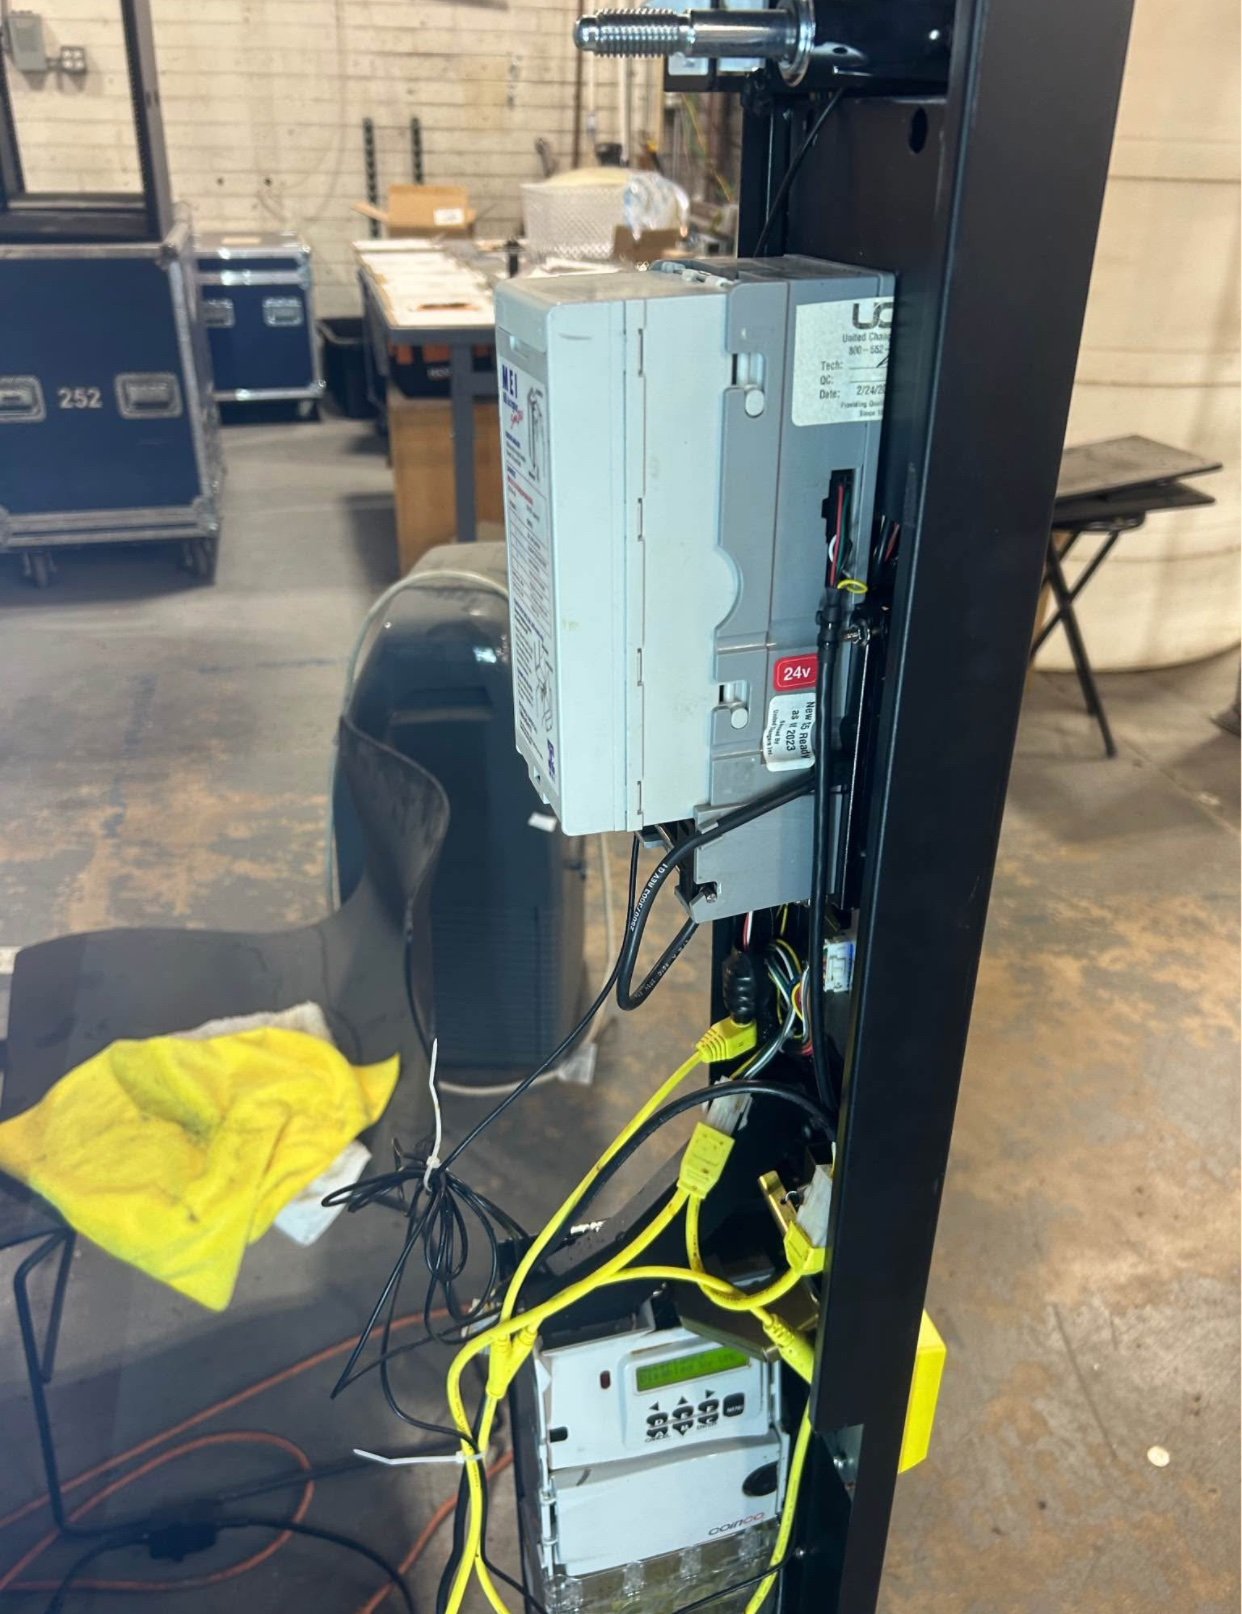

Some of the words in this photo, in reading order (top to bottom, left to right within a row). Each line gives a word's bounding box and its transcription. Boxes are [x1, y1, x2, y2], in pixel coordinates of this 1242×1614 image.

[842, 333, 867, 344] United
[821, 360, 843, 371] Tech:
[502, 364, 518, 399] MEI
[820, 375, 834, 385] QC:
[57, 387, 104, 409] 252
[819, 389, 841, 399] Date:
[783, 666, 811, 681] 24v
[791, 710, 800, 720] as
[805, 701, 815, 721] New
[786, 730, 796, 751] 2023
[799, 732, 812, 759] Ready
[647, 872, 663, 890] REV
[708, 1511, 765, 1536] coinco
